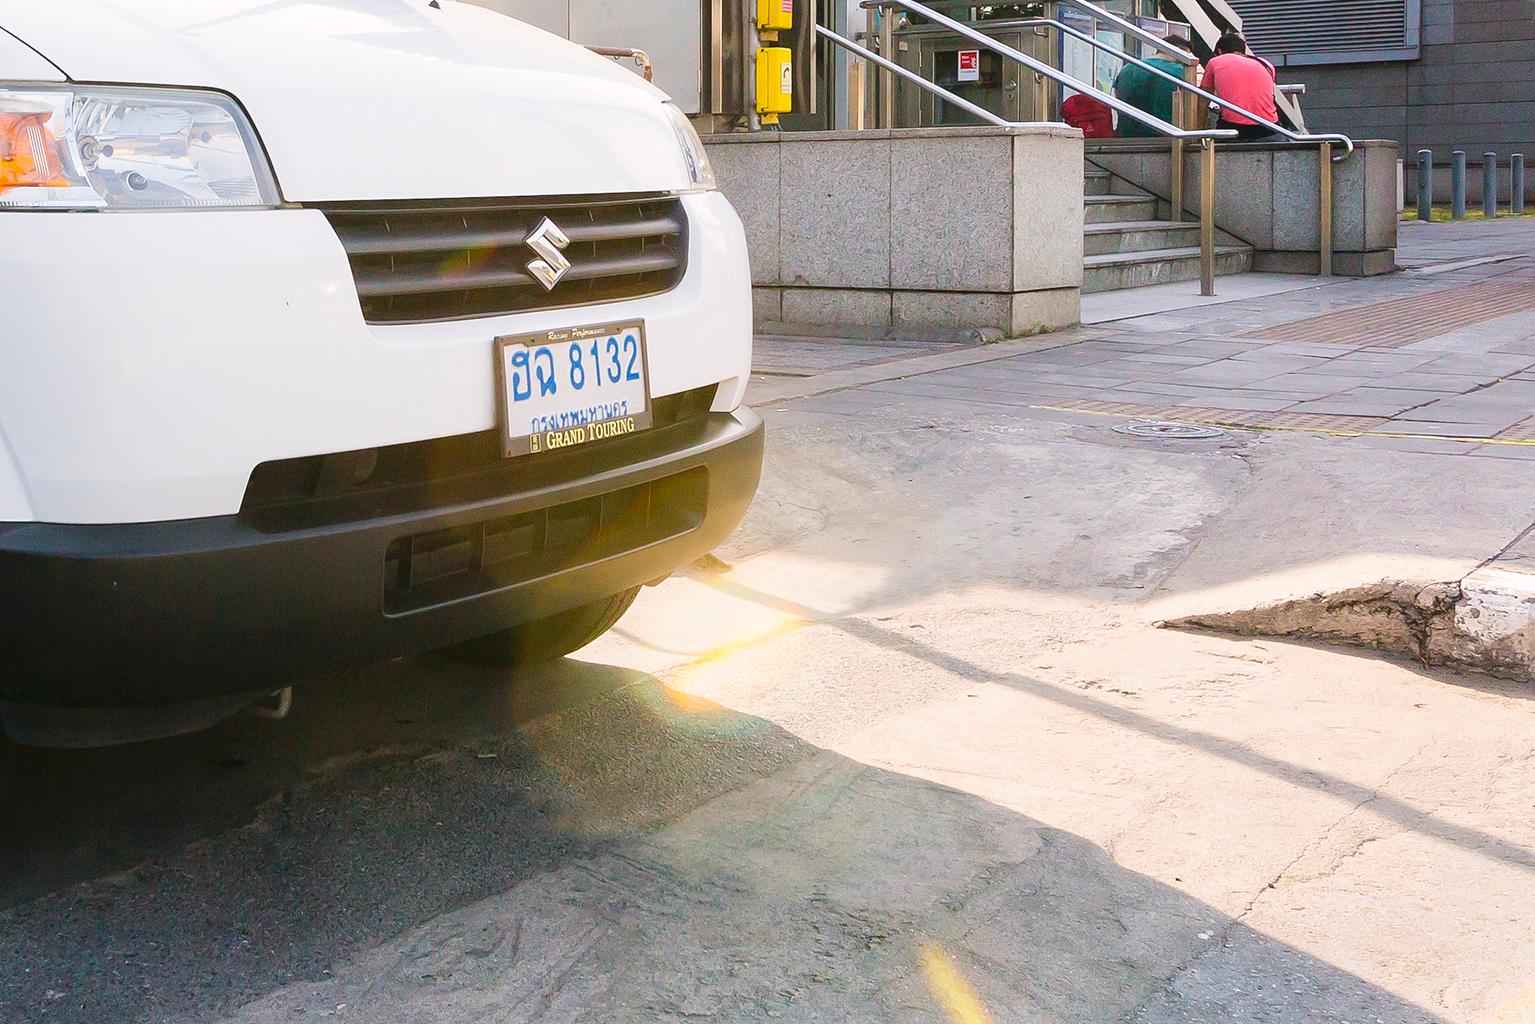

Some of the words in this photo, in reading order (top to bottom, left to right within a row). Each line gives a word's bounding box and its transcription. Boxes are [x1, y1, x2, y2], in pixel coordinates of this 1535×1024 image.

[569, 334, 640, 390] 8132
[531, 400, 628, 432] กรงเทพมหานคร
[546, 428, 585, 450] GRAND
[587, 417, 635, 441] TOURING
